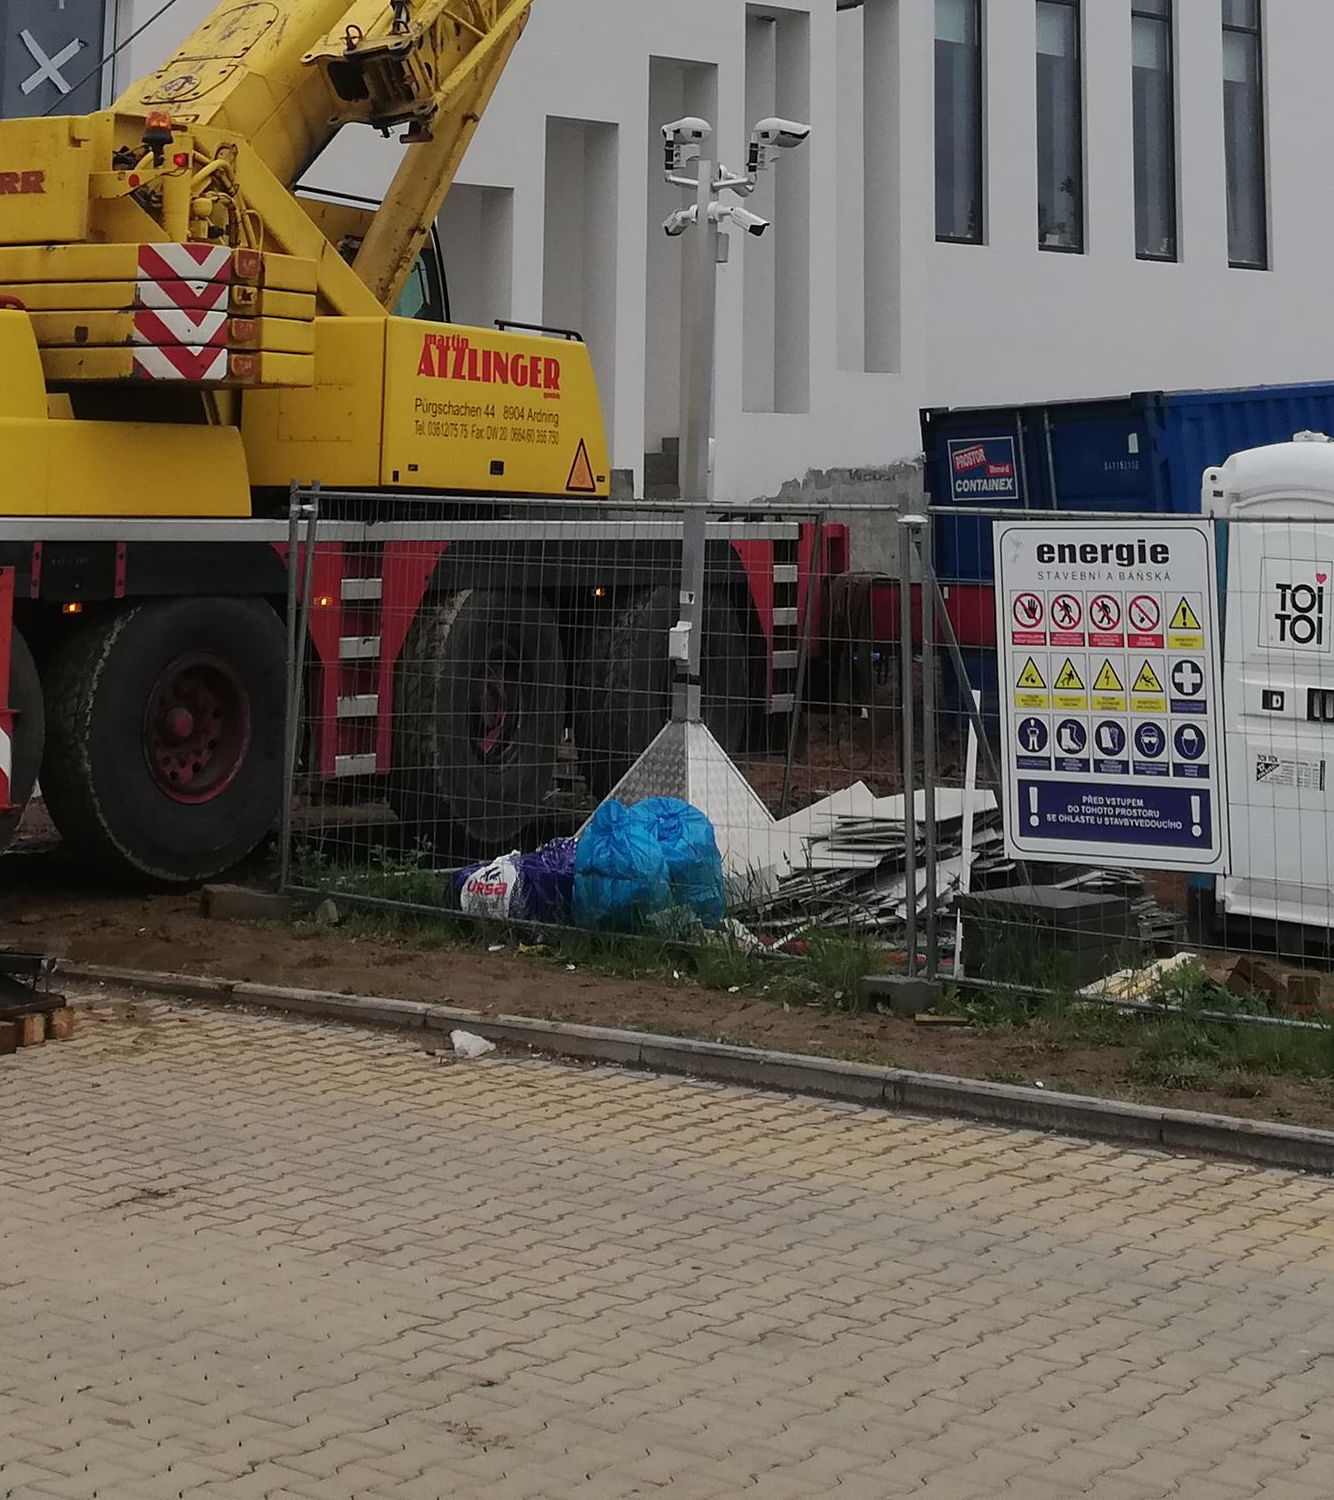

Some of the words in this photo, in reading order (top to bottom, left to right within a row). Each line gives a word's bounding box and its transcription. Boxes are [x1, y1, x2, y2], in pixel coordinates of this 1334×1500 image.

[424, 333, 469, 350] martin
[417, 343, 560, 390] ATZLINGER
[414, 398, 482, 418] Pürgschachen
[483, 404, 495, 417] 44
[502, 405, 525, 421] 8904
[526, 408, 560, 427] Ardning
[486, 426, 499, 441] DW
[499, 427, 507, 441] 20
[955, 478, 1013, 492] CONTAINEX
[1036, 539, 1170, 567] energie
[1037, 571, 1100, 581] STAVEBNÍ
[1106, 572, 1113, 581] A
[1275, 583, 1324, 614] TOI
[1274, 613, 1323, 645] TOI
[1082, 794, 1104, 805] PŘED
[1105, 796, 1144, 807] VSTUPEM
[1068, 805, 1080, 813] DO
[1081, 806, 1114, 815] TOHOTO
[1116, 807, 1160, 818] PROSTORU
[1046, 813, 1057, 822] SE
[1059, 814, 1095, 824] OHLASTE
[1097, 816, 1102, 824] U
[1104, 817, 1182, 830] STAVBYVEDOUCÍHO
